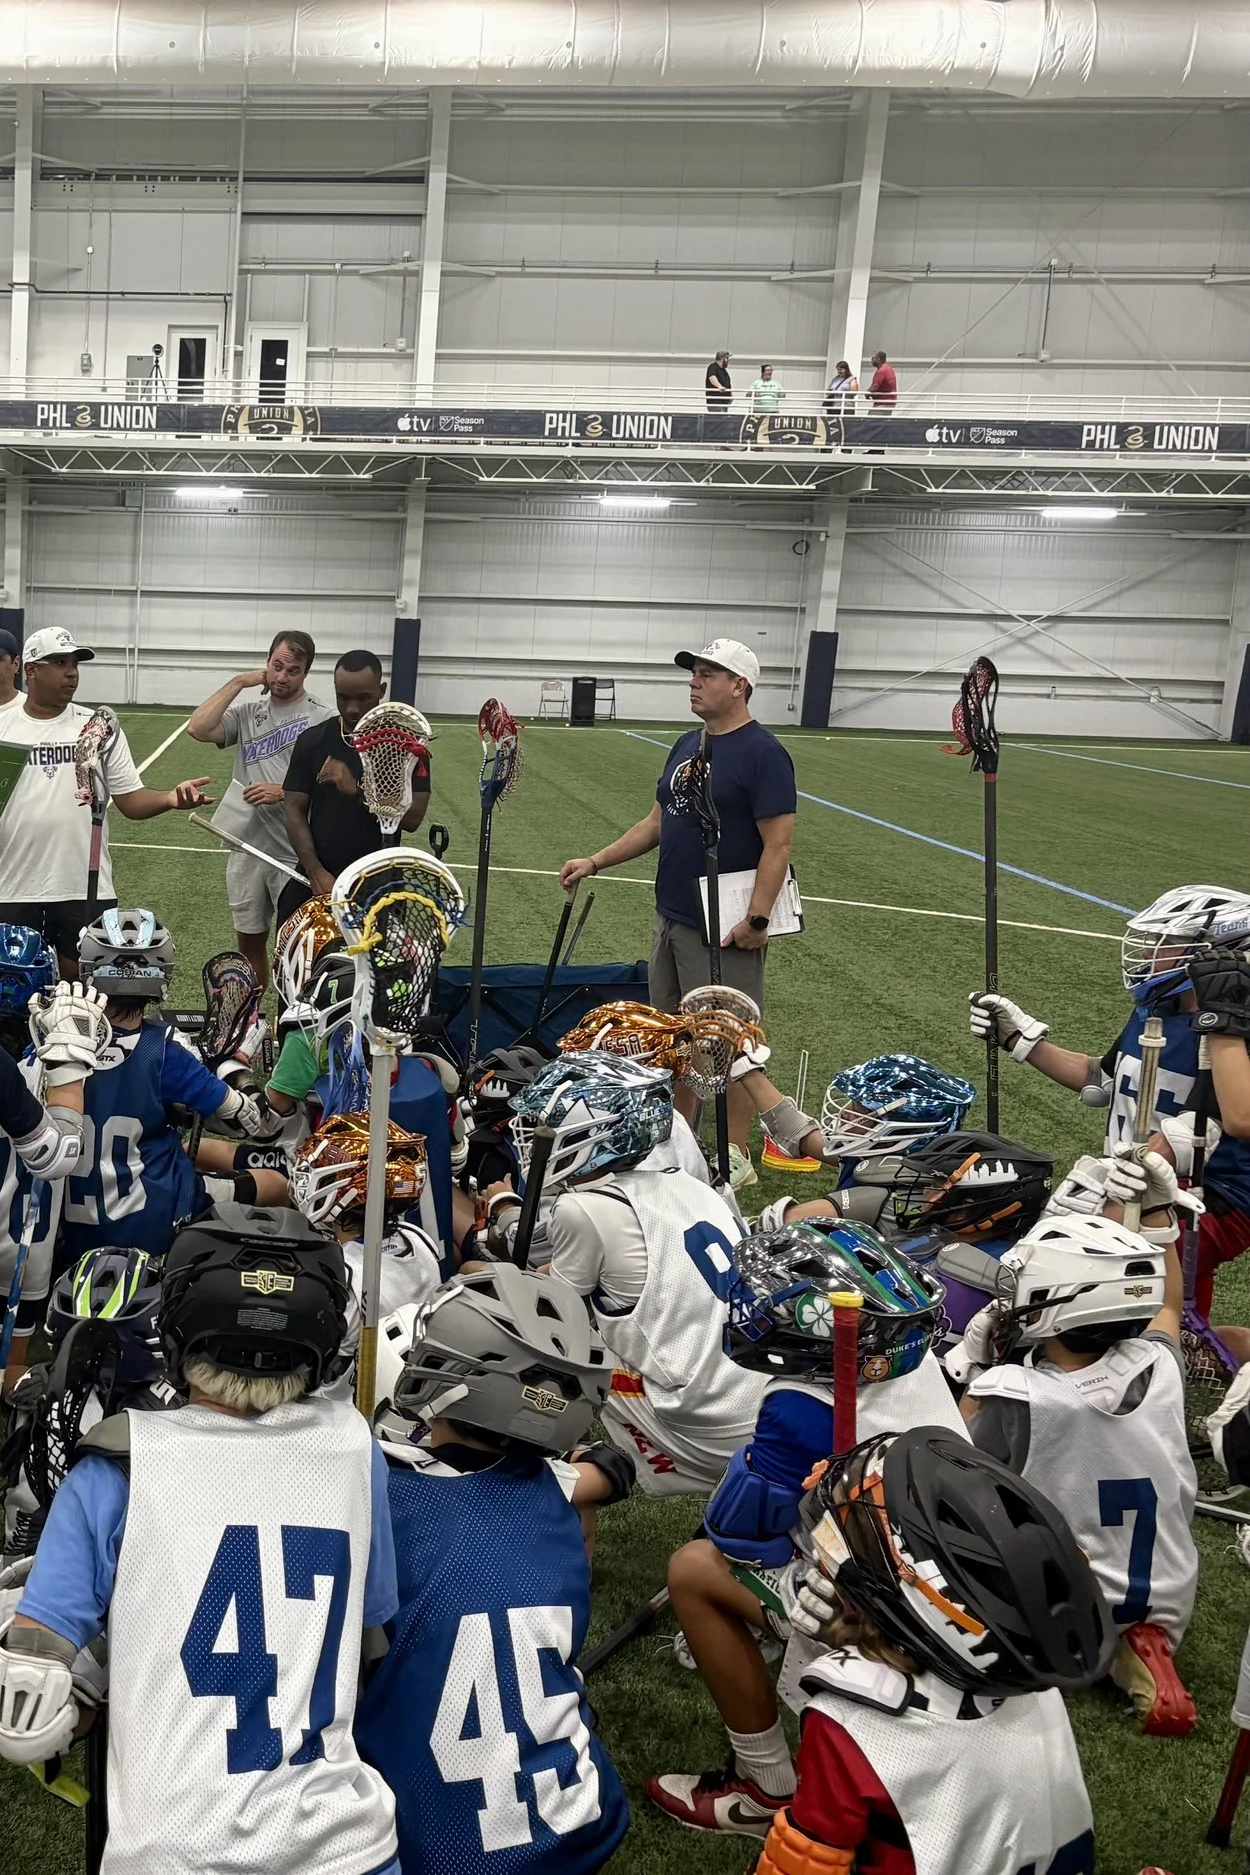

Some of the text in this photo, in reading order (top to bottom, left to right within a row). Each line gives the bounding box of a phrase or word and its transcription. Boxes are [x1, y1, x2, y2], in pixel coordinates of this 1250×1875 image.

[36, 403, 157, 429] PHL UNION
[253, 406, 289, 419] UNION
[454, 416, 485, 425] Season
[411, 415, 431, 432] tv
[453, 424, 473, 432] Pass
[544, 412, 673, 439] PHL UNION
[774, 417, 812, 429] UNION
[940, 426, 962, 443] tv
[984, 436, 1006, 445] Pass
[986, 427, 1018, 437] Season
[1080, 424, 1220, 451] PHL UNION
[1096, 1477, 1158, 1625] 7
[179, 1524, 351, 1775] 47
[422, 1605, 603, 1853] 45
